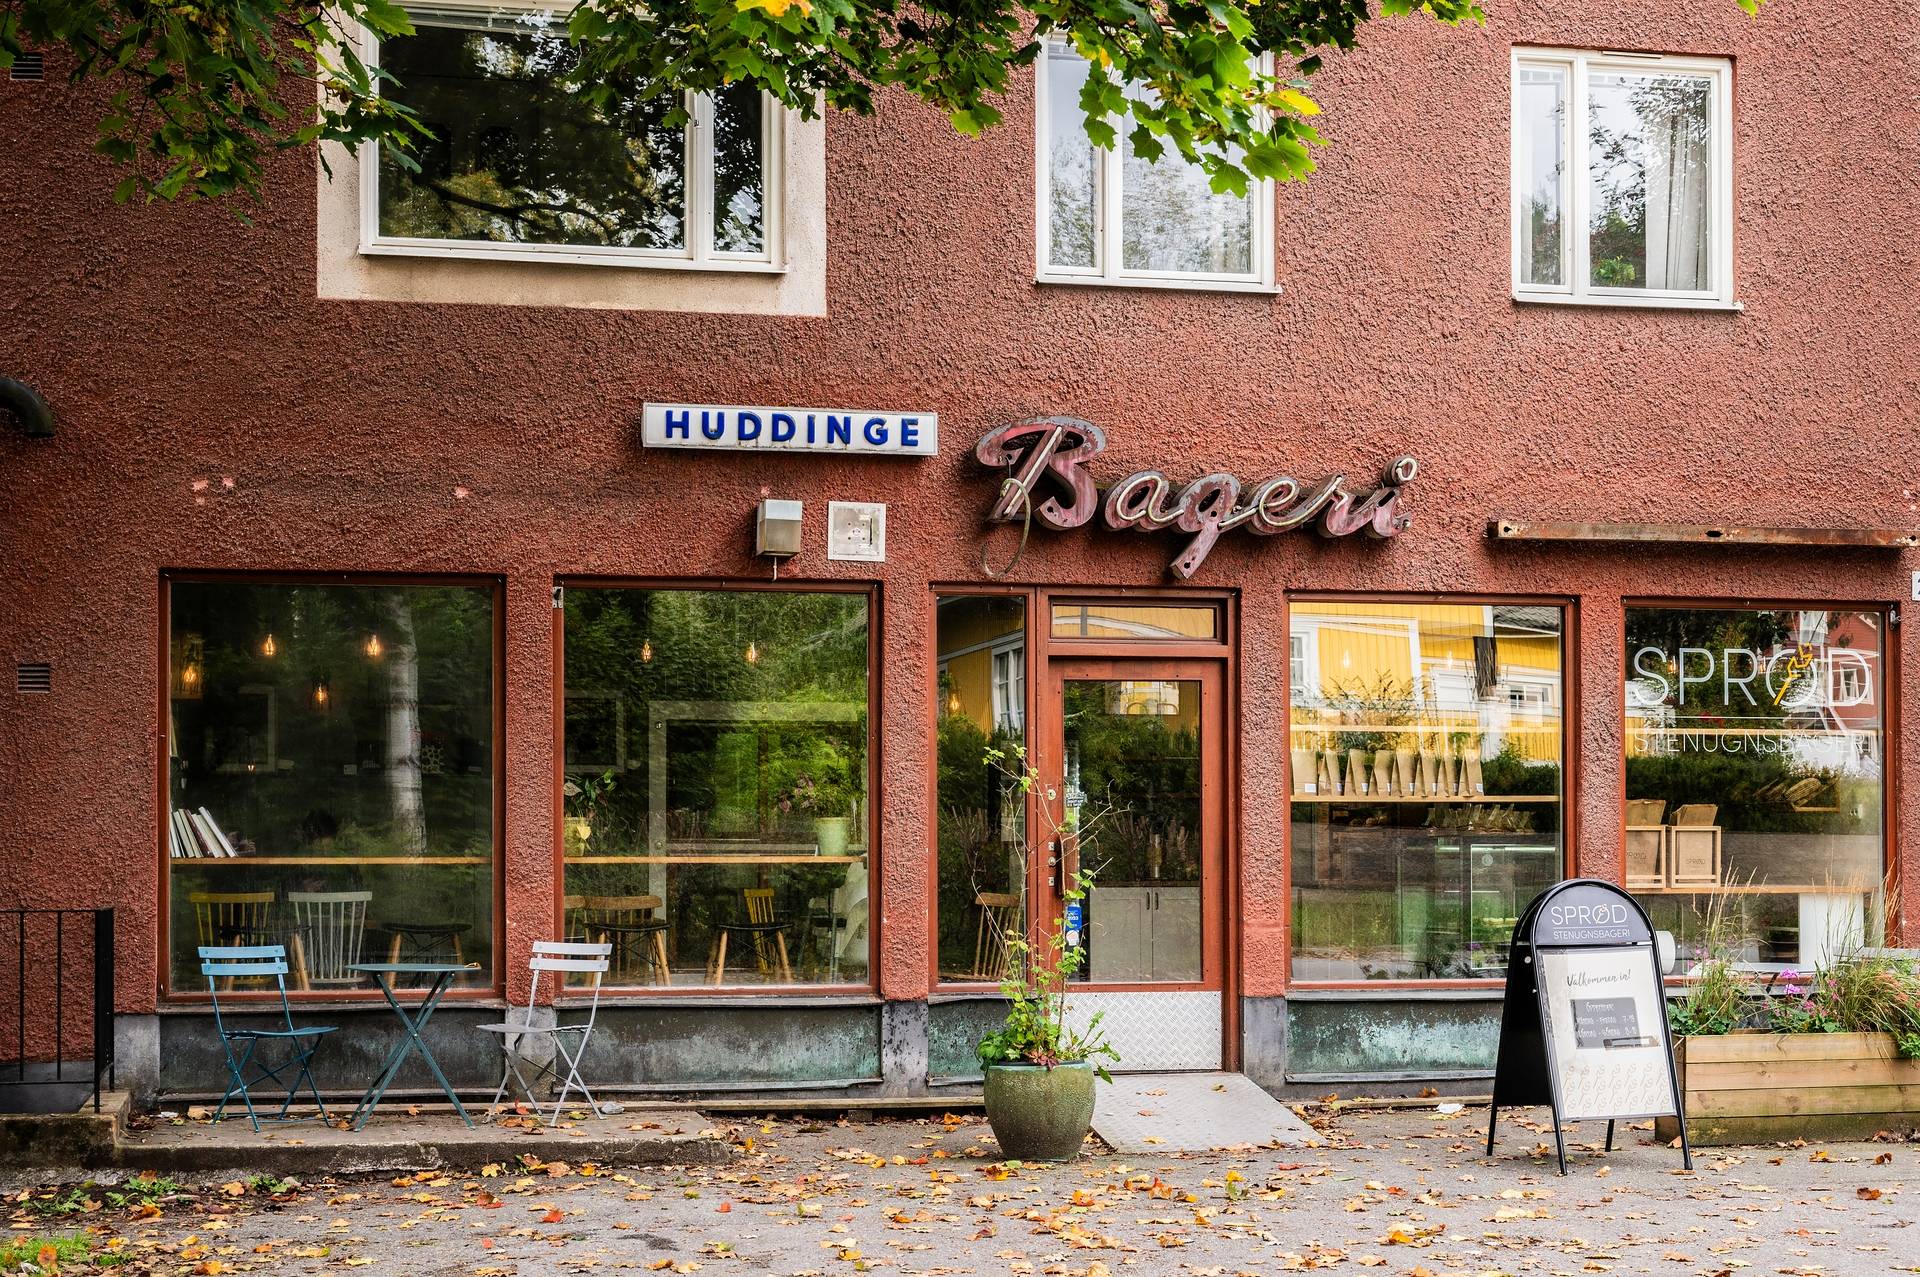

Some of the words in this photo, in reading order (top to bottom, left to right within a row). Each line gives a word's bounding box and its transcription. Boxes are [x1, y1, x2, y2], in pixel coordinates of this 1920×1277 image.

[665, 410, 919, 446] HUDDINGE
[973, 415, 1419, 579] Bageri
[1633, 728, 1873, 754] STENUGNSBAGERI
[1553, 929, 1631, 940] STENUGNSBAGERI
